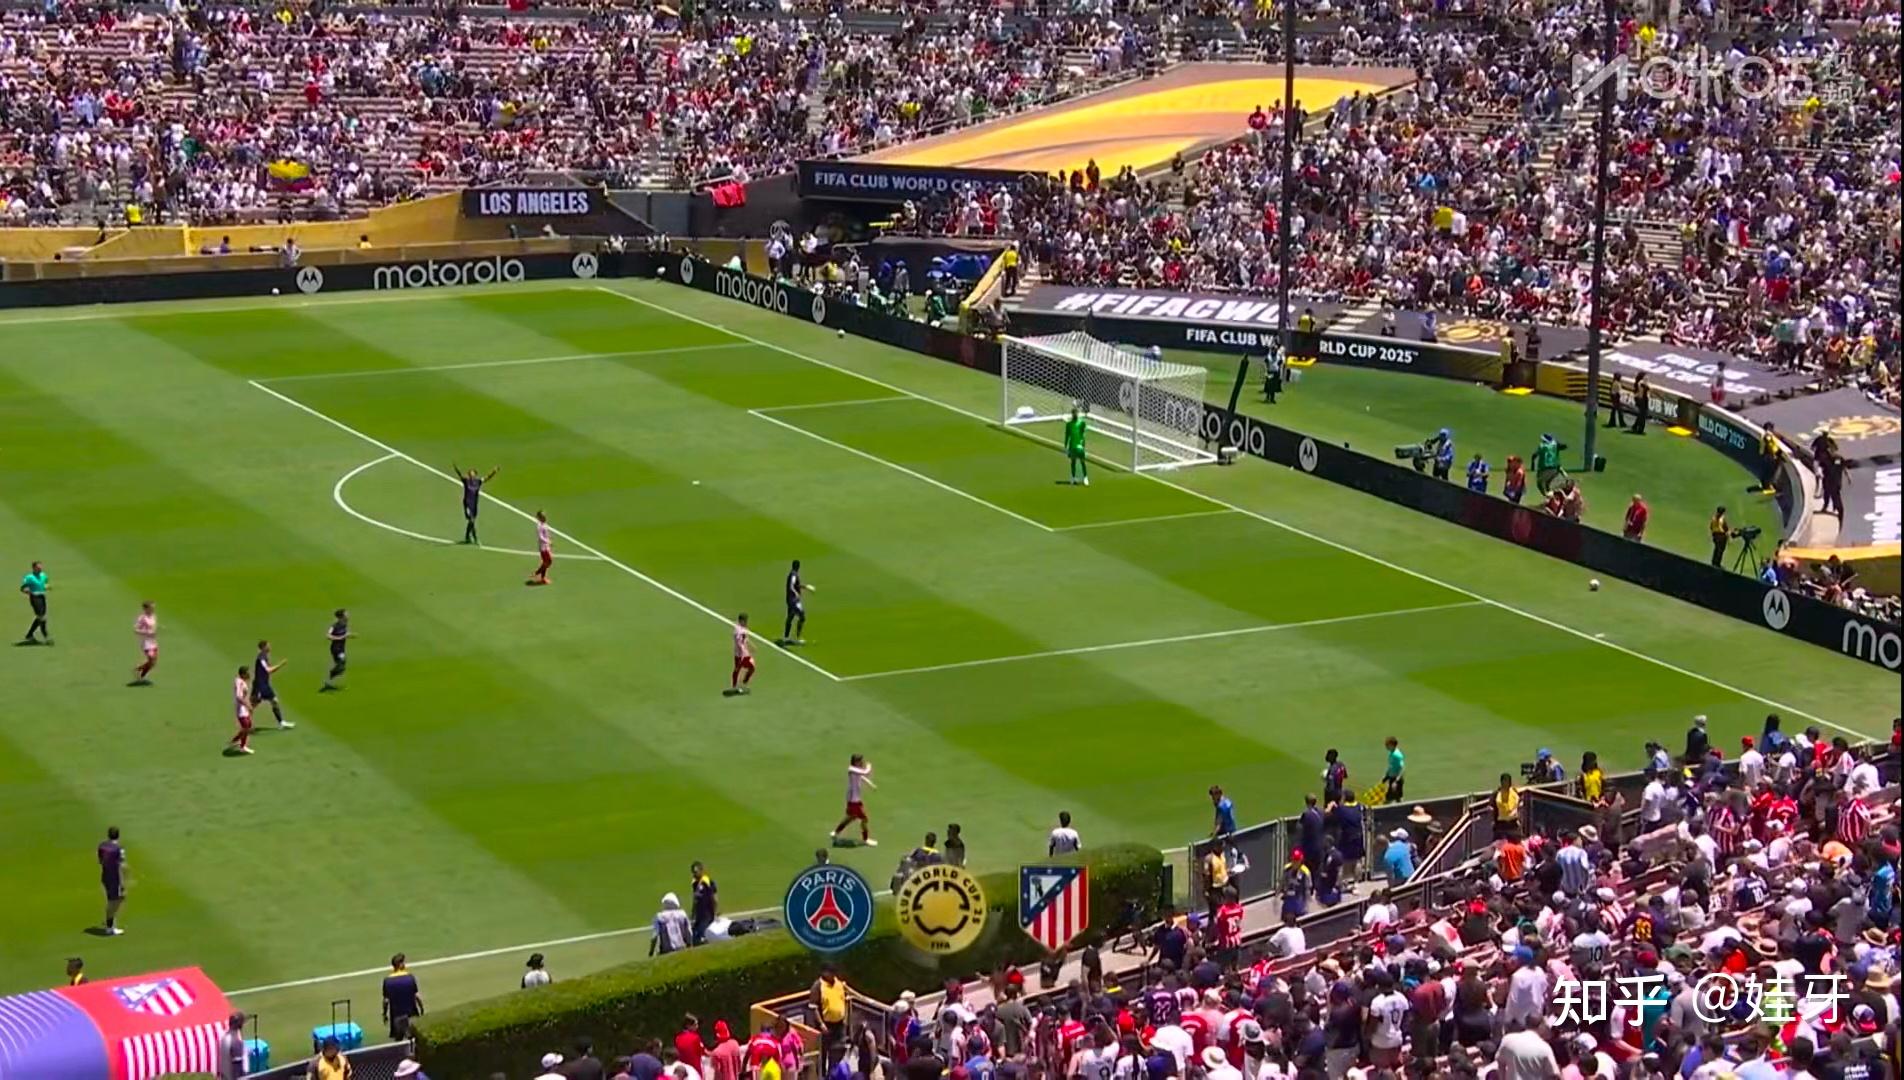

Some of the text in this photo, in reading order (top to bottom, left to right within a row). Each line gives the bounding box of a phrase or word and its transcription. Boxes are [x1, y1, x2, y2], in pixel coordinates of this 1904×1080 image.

[814, 171, 847, 186] FIFA
[850, 174, 888, 189] CLUB
[480, 192, 589, 215] LOS ANGELES
[374, 255, 525, 290] motorola
[716, 271, 788, 314] motorola
[1186, 328, 1216, 343] FIFA
[1220, 331, 1257, 345] CLUB
[1349, 343, 1377, 358] CUP
[1164, 400, 1265, 457] motoola
